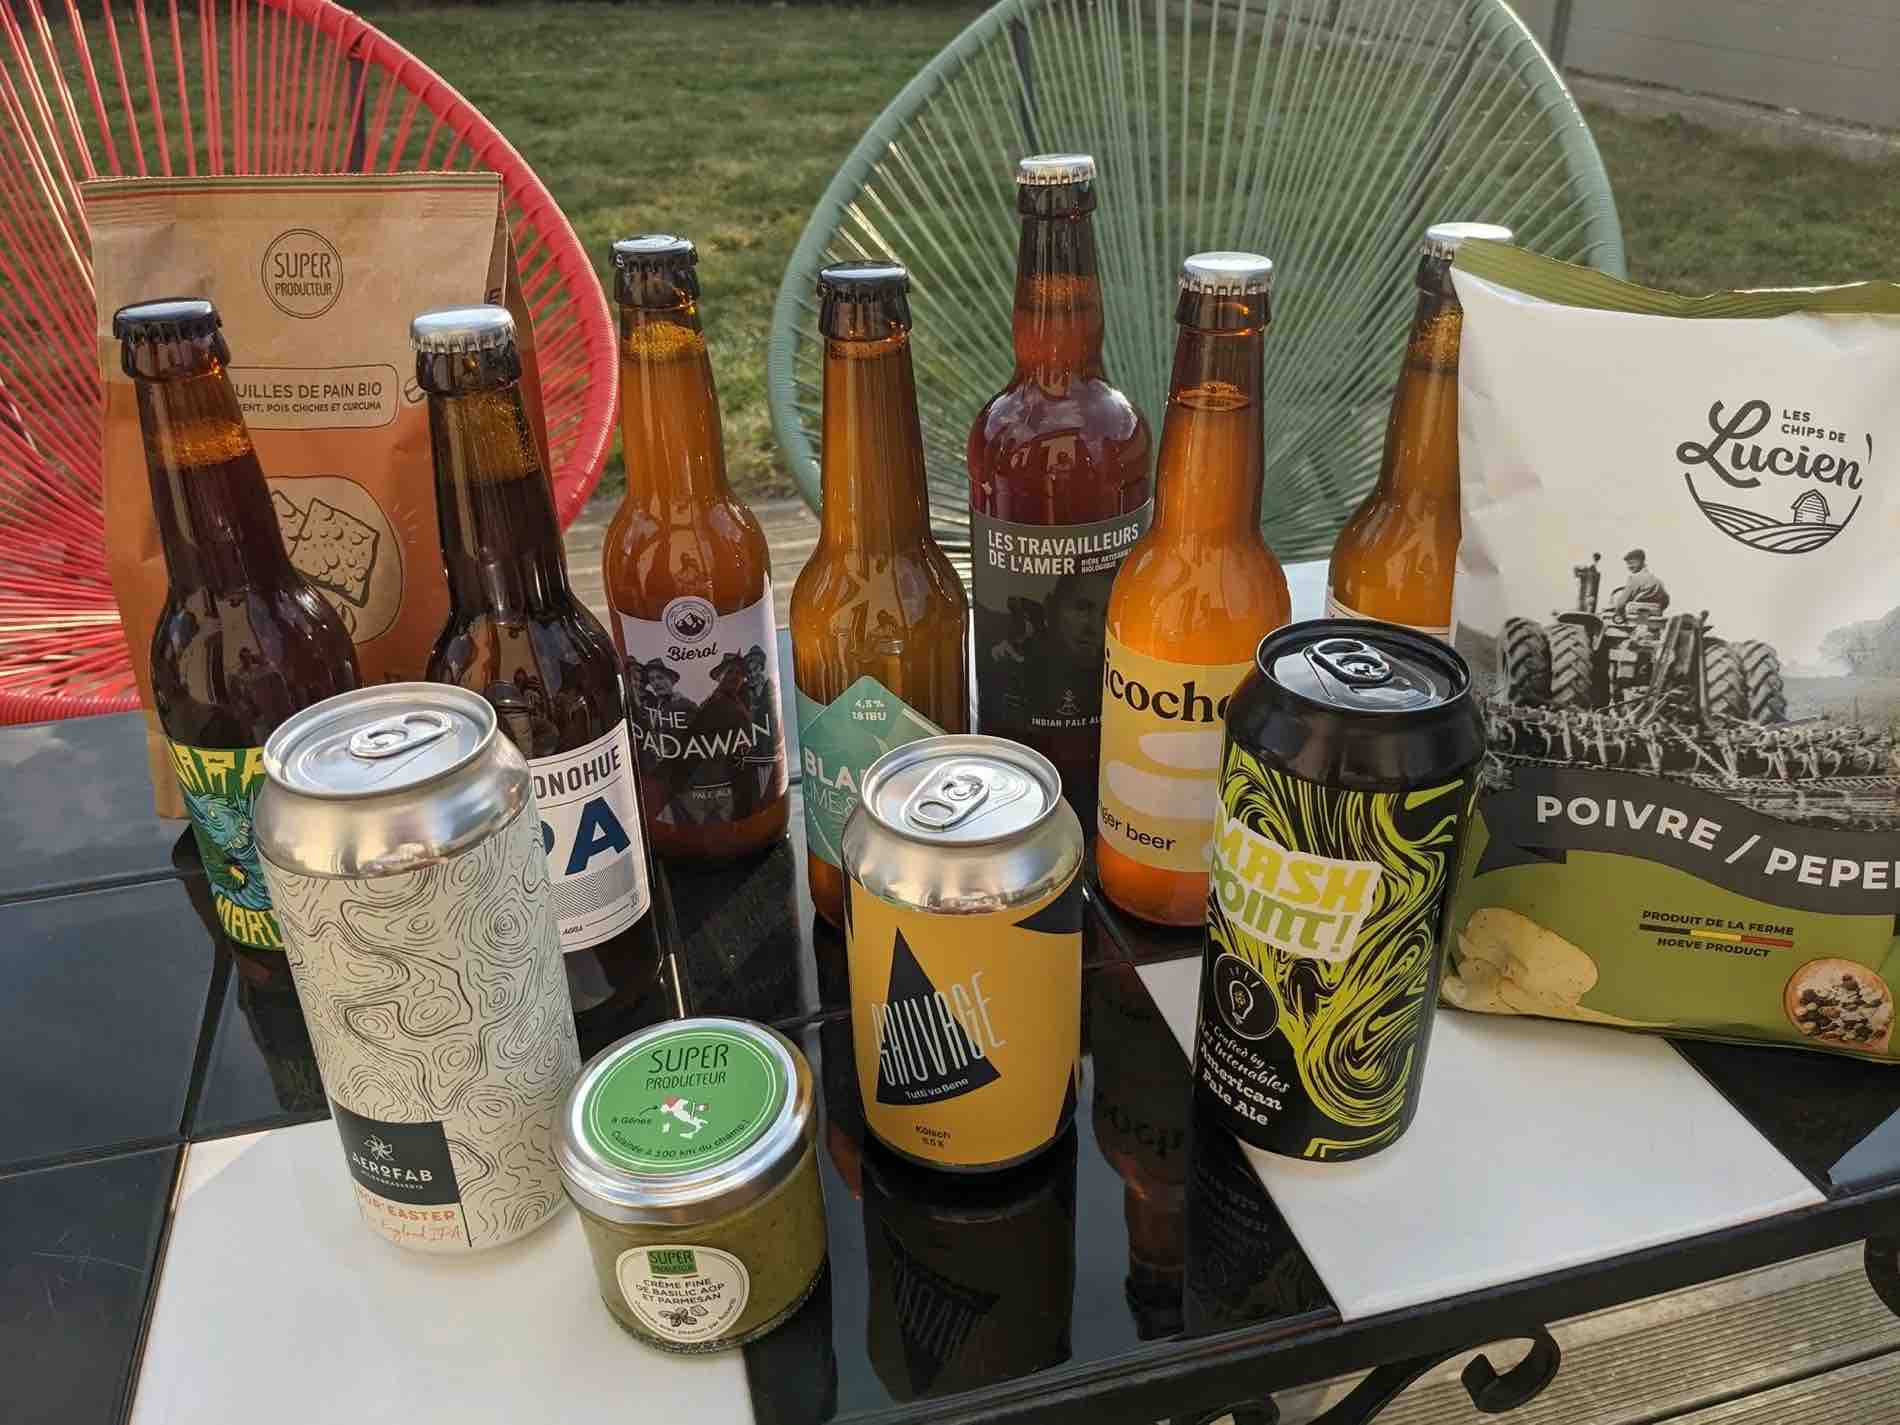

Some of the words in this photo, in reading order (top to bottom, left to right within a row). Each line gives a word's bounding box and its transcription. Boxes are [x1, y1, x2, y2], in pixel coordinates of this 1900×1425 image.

[273, 252, 331, 278] SUPER
[274, 281, 334, 297] PRODUCTEUR
[233, 383, 293, 399] UILLES
[297, 384, 319, 399] DE
[323, 384, 354, 398] PAIN
[358, 381, 382, 396] BIO
[266, 402, 290, 413] POIS
[293, 403, 329, 413] CHICHES
[331, 403, 341, 412] ET
[342, 401, 381, 412] CURCUMA
[1783, 409, 1811, 423] LES
[1675, 399, 1864, 490] Lucien
[1781, 423, 1825, 440] CHIPS
[1828, 430, 1848, 443] DE
[988, 528, 1014, 552] LES
[1016, 522, 1140, 557] TRAVAILLEURS
[988, 549, 1007, 569] DE
[1010, 554, 1076, 576] L'AMER
[667, 642, 719, 662] Bierol
[644, 704, 689, 730] THE
[1065, 717, 1087, 728] PALE
[1089, 714, 1100, 724] AL
[631, 713, 772, 761] PADAWAN
[803, 746, 865, 794] BLA
[1126, 821, 1177, 851] beer
[1535, 794, 1723, 851] POIVRE
[1724, 833, 1762, 864] /
[1763, 847, 1900, 891] PEPE
[1641, 909, 1703, 926] PRODUIT
[1704, 916, 1725, 929] DE
[1727, 918, 1746, 932] LA
[1748, 920, 1795, 937] FERME
[1656, 936, 1703, 952] HOEVE
[1704, 942, 1770, 959] PRODUCT
[871, 969, 1008, 1088] SAUVAGE
[648, 1043, 730, 1075] SUPER
[645, 1071, 727, 1091] PRODUCTEUR
[1201, 1042, 1283, 1111] American
[904, 1089, 927, 1100] Tutti
[1202, 1067, 1233, 1105] Pale
[1233, 1100, 1269, 1126] Ale
[352, 1151, 434, 1183] AEROFAB
[387, 1205, 456, 1222] EASTER
[649, 1250, 694, 1266] SUPER
[652, 1287, 697, 1297] BASILIC
[684, 1278, 712, 1288] FINE
[658, 1292, 721, 1305] PARMESAN
